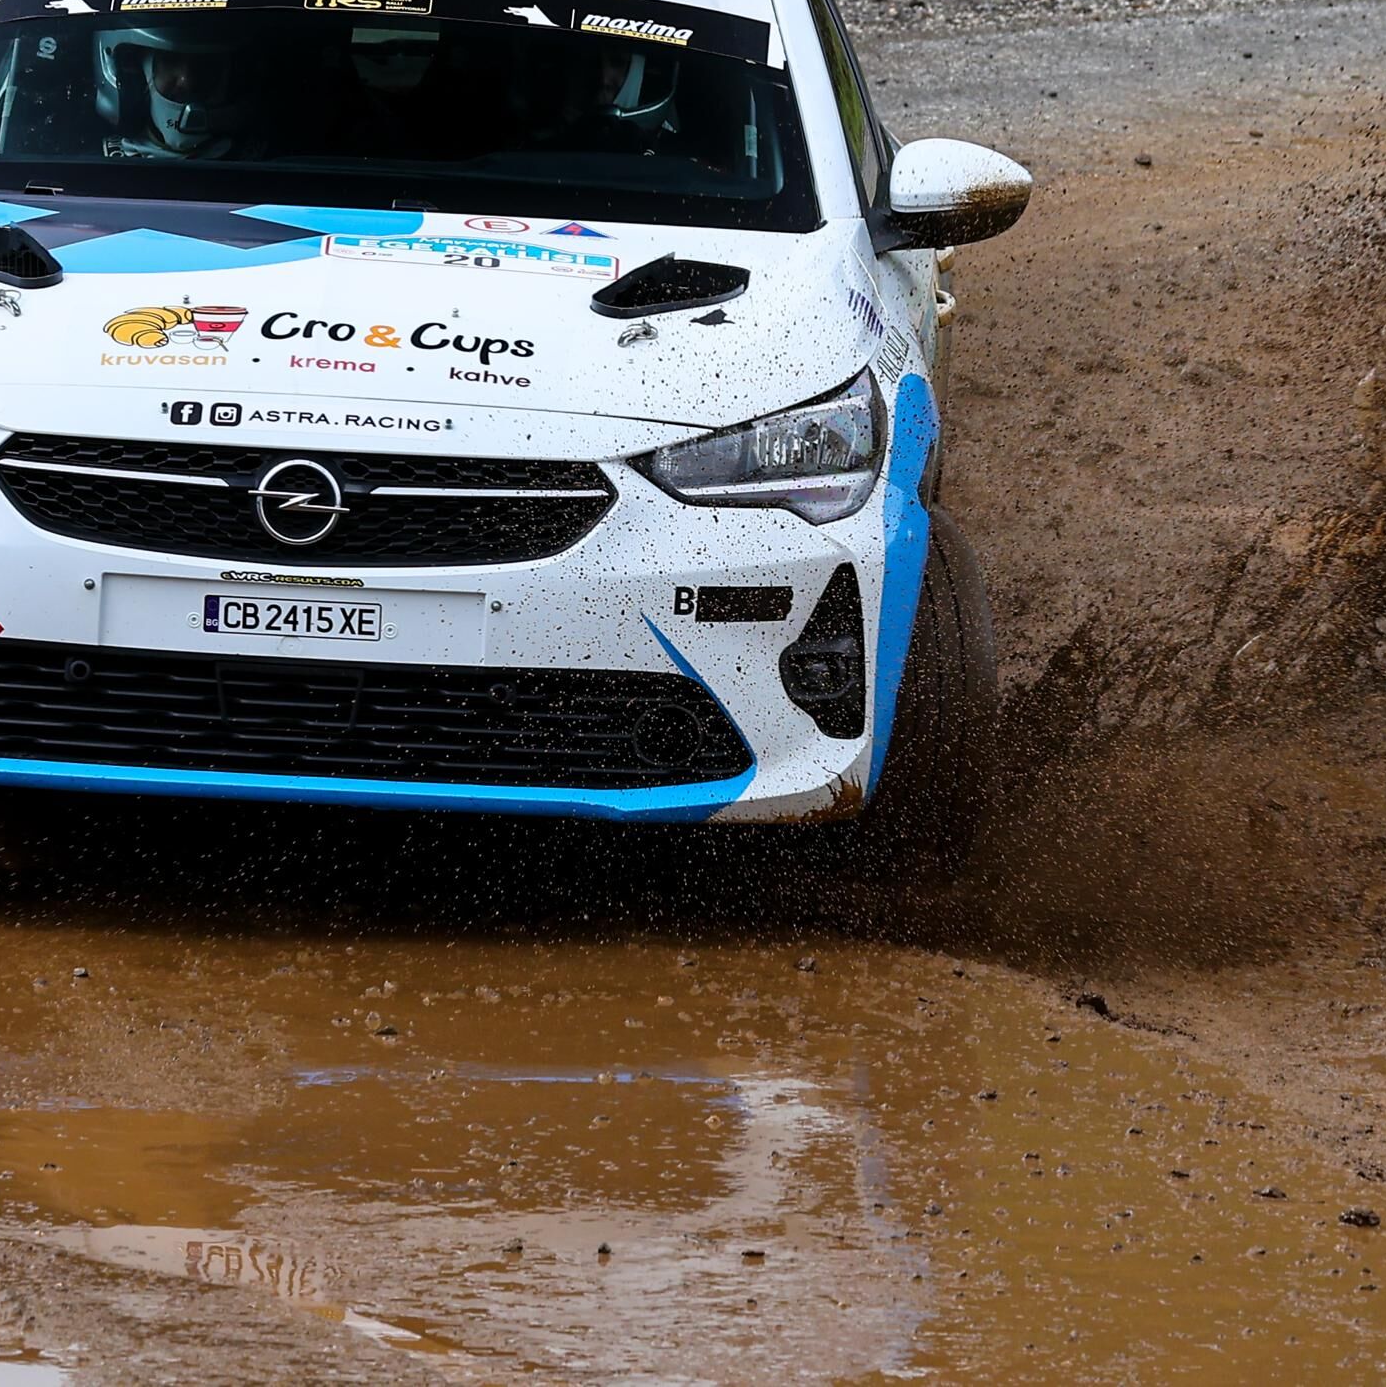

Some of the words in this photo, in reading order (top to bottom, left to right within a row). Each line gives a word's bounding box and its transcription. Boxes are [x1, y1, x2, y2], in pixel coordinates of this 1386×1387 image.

[581, 14, 693, 40] maxima
[360, 239, 433, 252] EGE
[419, 237, 526, 251] Marmaris
[443, 254, 501, 268] 20
[261, 312, 355, 341] Cro
[364, 325, 402, 348] &
[410, 323, 534, 365] Cups
[100, 353, 227, 366] kruvasan
[289, 355, 376, 372] krema
[449, 367, 531, 387] kahve
[206, 618, 218, 627] BG
[223, 601, 260, 629] CB
[265, 604, 334, 632] 2415
[339, 607, 376, 635] XE
